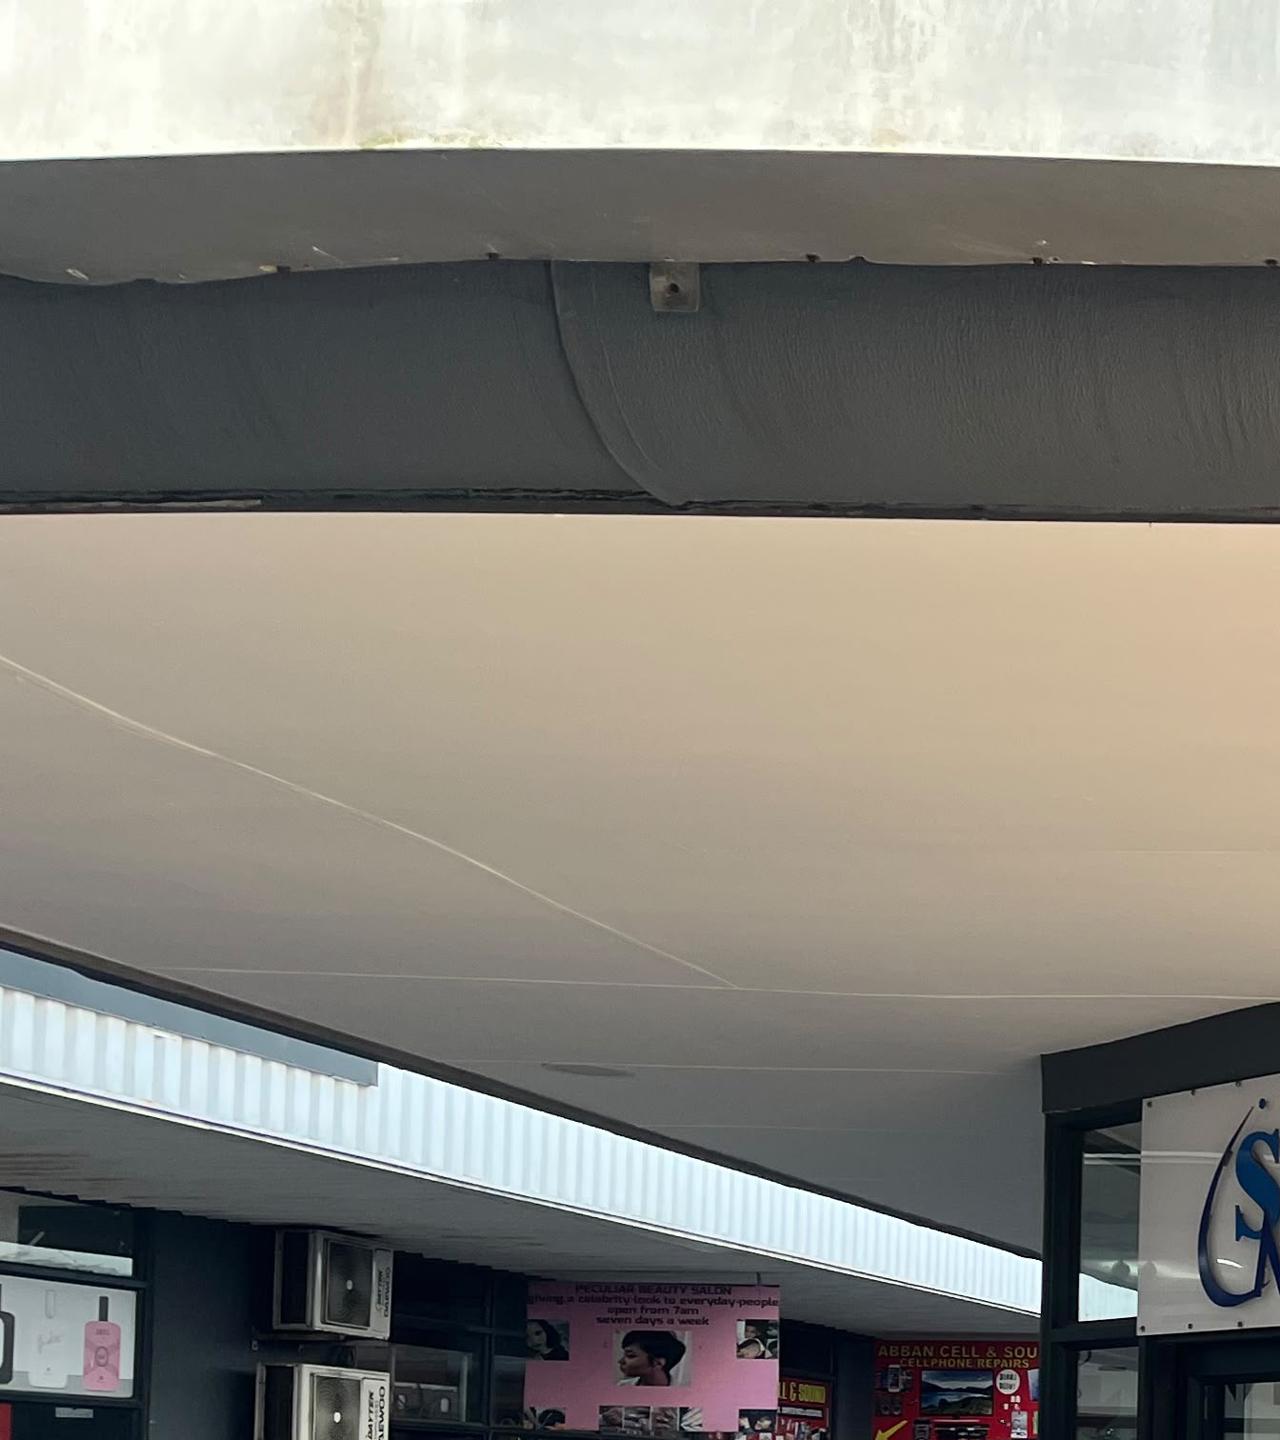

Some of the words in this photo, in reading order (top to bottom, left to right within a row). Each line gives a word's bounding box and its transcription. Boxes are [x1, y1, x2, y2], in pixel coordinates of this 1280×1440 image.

[691, 1285, 732, 1296] SALON
[607, 1306, 636, 1316] open
[640, 1305, 669, 1315] from
[674, 1306, 699, 1315] 7am
[596, 1316, 631, 1325] seven
[635, 1315, 664, 1327] days
[678, 1317, 709, 1326] week
[878, 1345, 935, 1357] ABBAN
[940, 1345, 980, 1358] CELL
[986, 1345, 997, 1358] &
[900, 1357, 974, 1369] CELLPHONE
[977, 1358, 1030, 1369] REPAIRS
